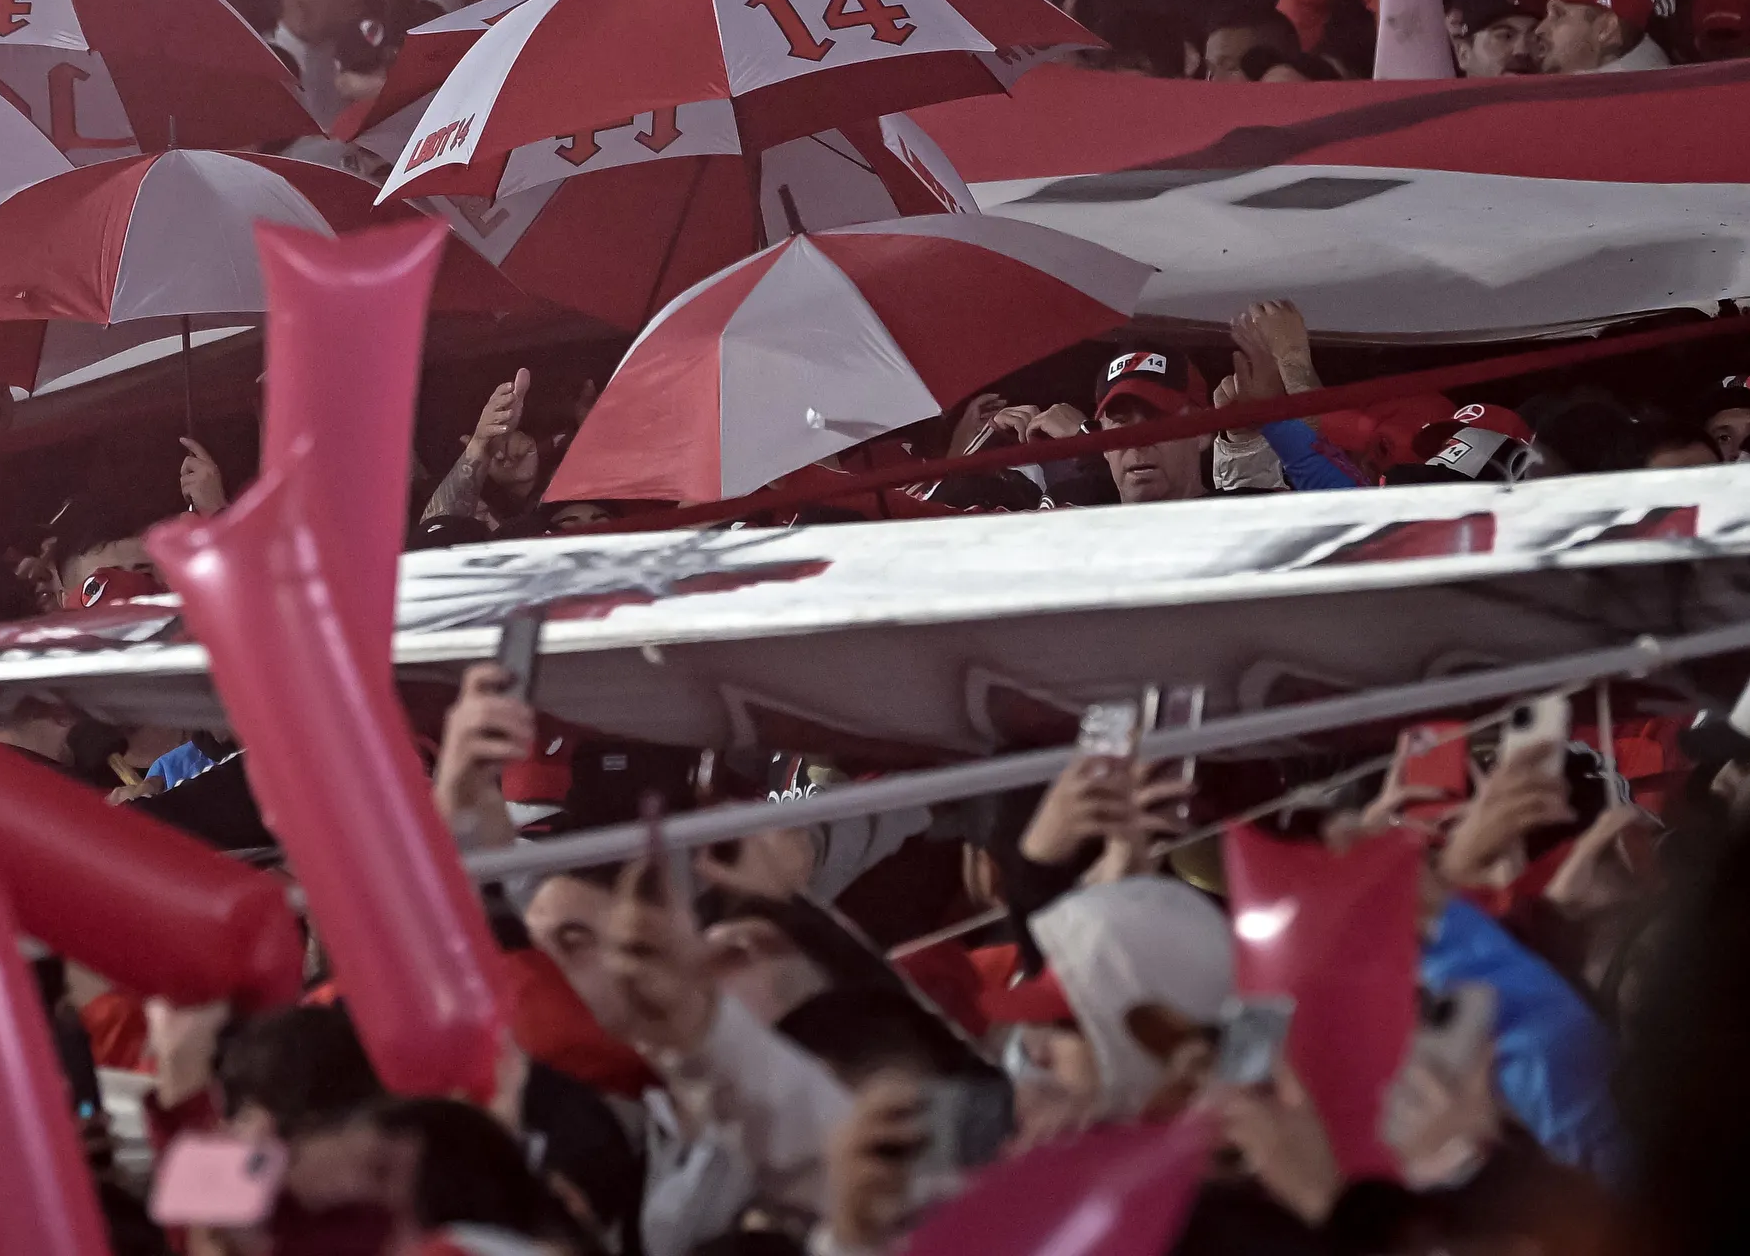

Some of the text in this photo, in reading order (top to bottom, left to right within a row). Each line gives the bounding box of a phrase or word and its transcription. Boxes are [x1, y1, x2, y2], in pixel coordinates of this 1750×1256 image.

[404, 112, 476, 174] LBDT 14
[1147, 357, 1163, 368] 14
